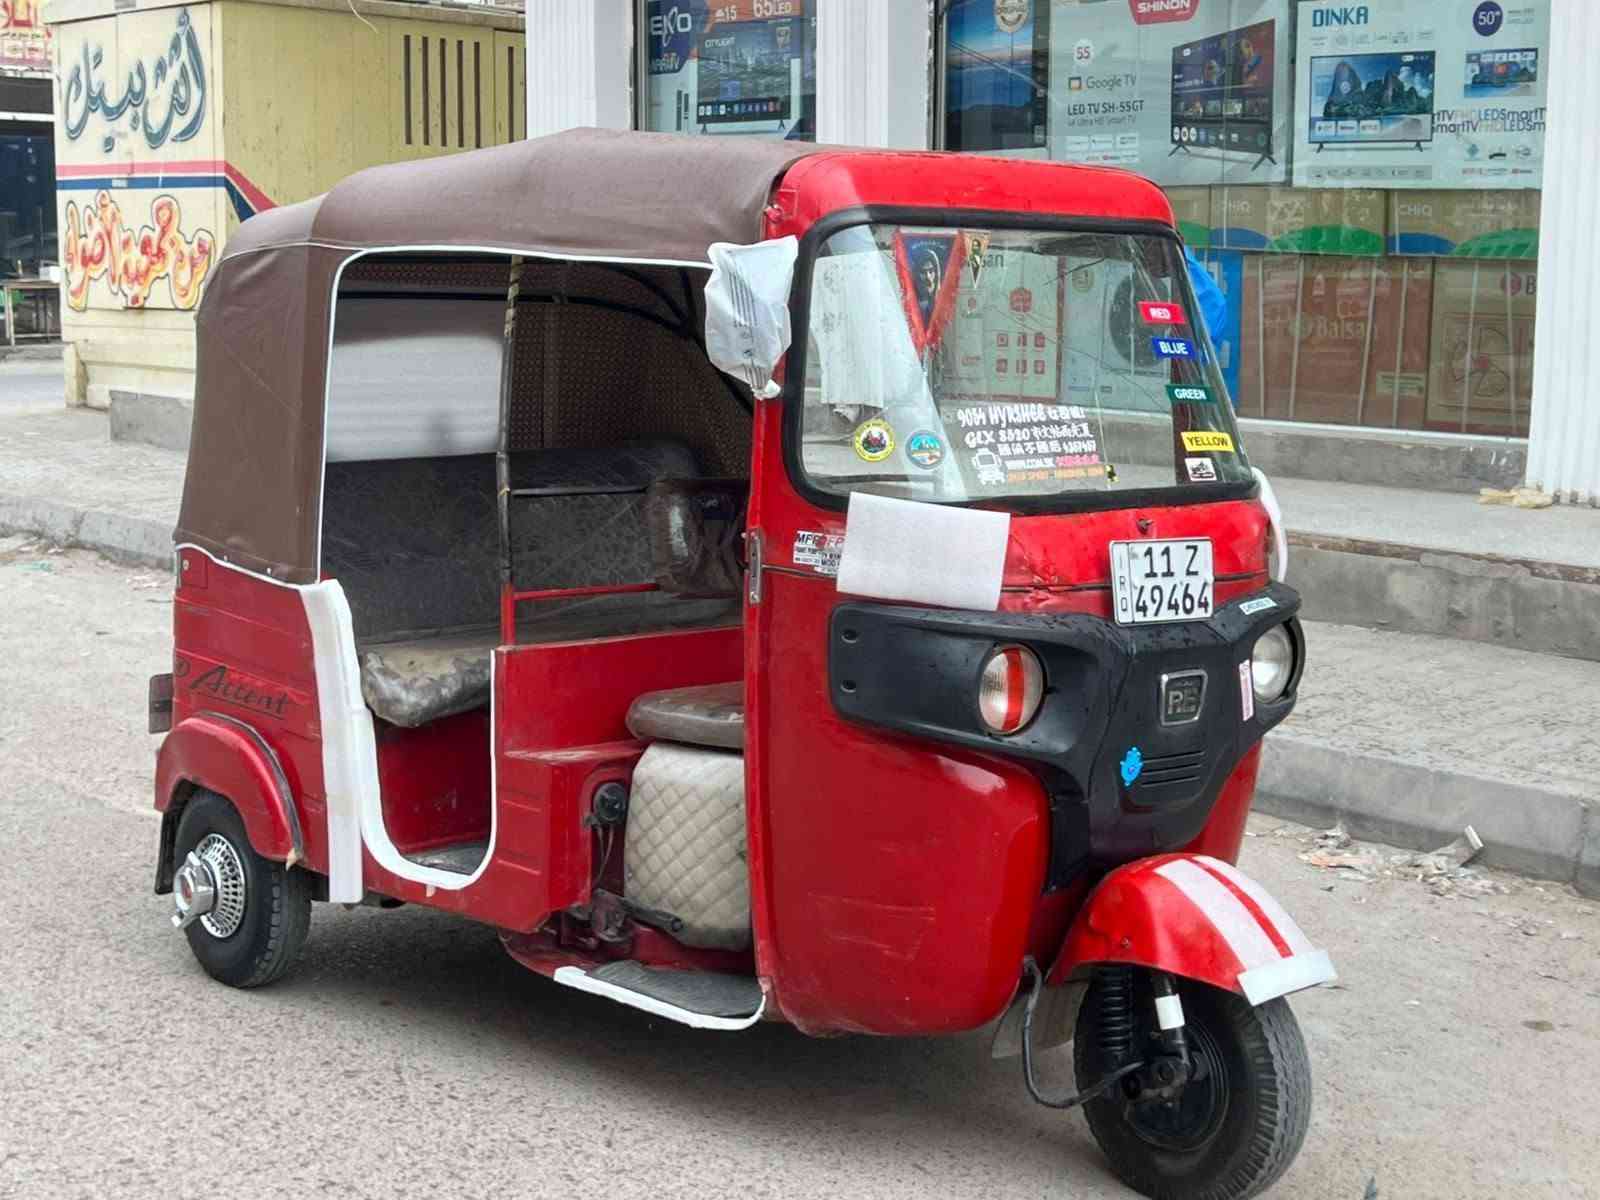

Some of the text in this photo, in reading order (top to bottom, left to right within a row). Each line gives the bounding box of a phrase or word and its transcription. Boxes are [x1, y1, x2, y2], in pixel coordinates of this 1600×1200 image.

[1137, 0, 1191, 13] SHINON
[1312, 6, 1369, 27] DINKA
[1086, 73, 1137, 91] Google TV
[1067, 103, 1086, 116] LED
[1088, 102, 1100, 114] TV
[1149, 308, 1172, 320] RED
[1158, 341, 1189, 355] BLUE
[1174, 388, 1207, 400] GREEN
[1186, 436, 1229, 447] YELLOW
[1144, 545, 1199, 578] 11 Z
[1135, 583, 1209, 618] 49464
